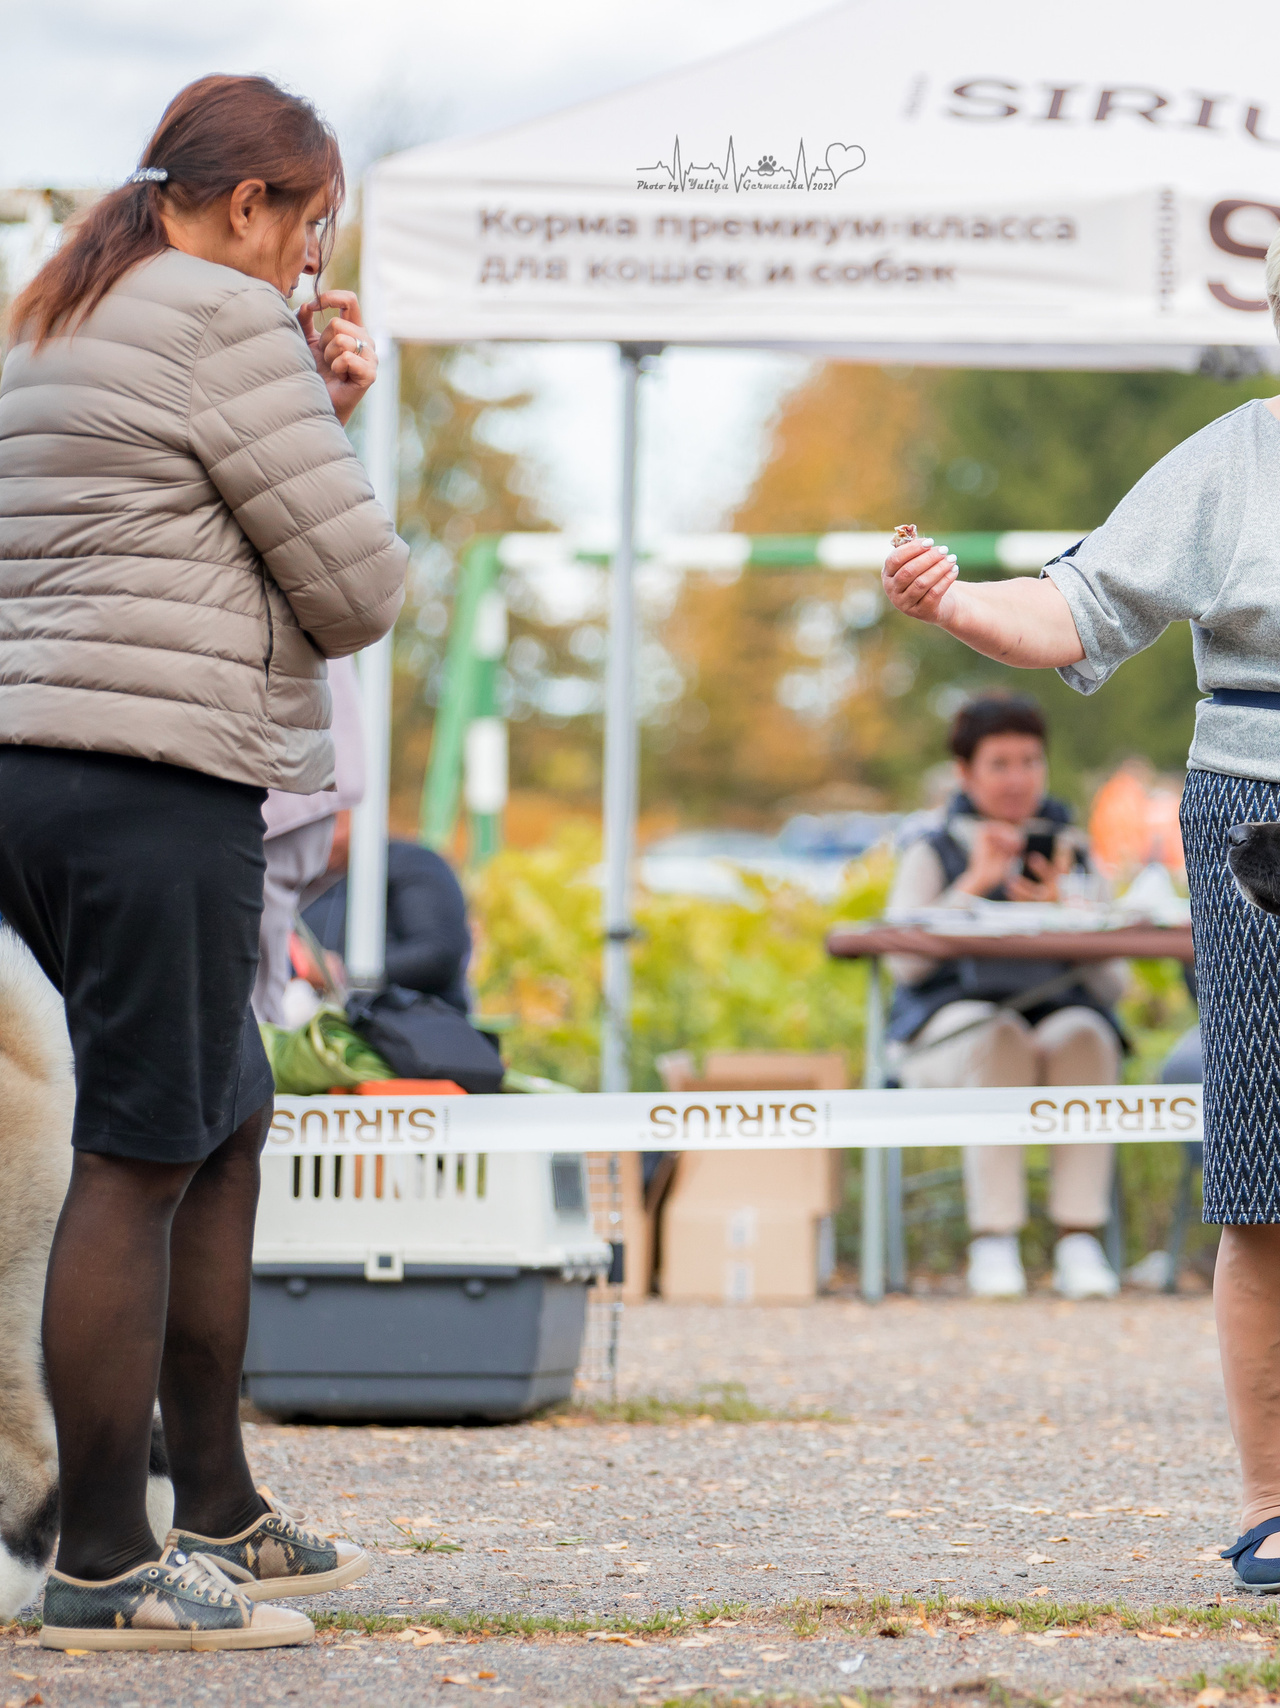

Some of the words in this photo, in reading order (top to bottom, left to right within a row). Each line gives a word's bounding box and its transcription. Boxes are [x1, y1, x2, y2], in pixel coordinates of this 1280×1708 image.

[480, 208, 638, 242] Корма
[766, 261, 795, 283] и
[268, 1108, 436, 1145] SIRIUS
[650, 1103, 817, 1139] SIRIUS
[1030, 1097, 1197, 1133] SIRIUS
